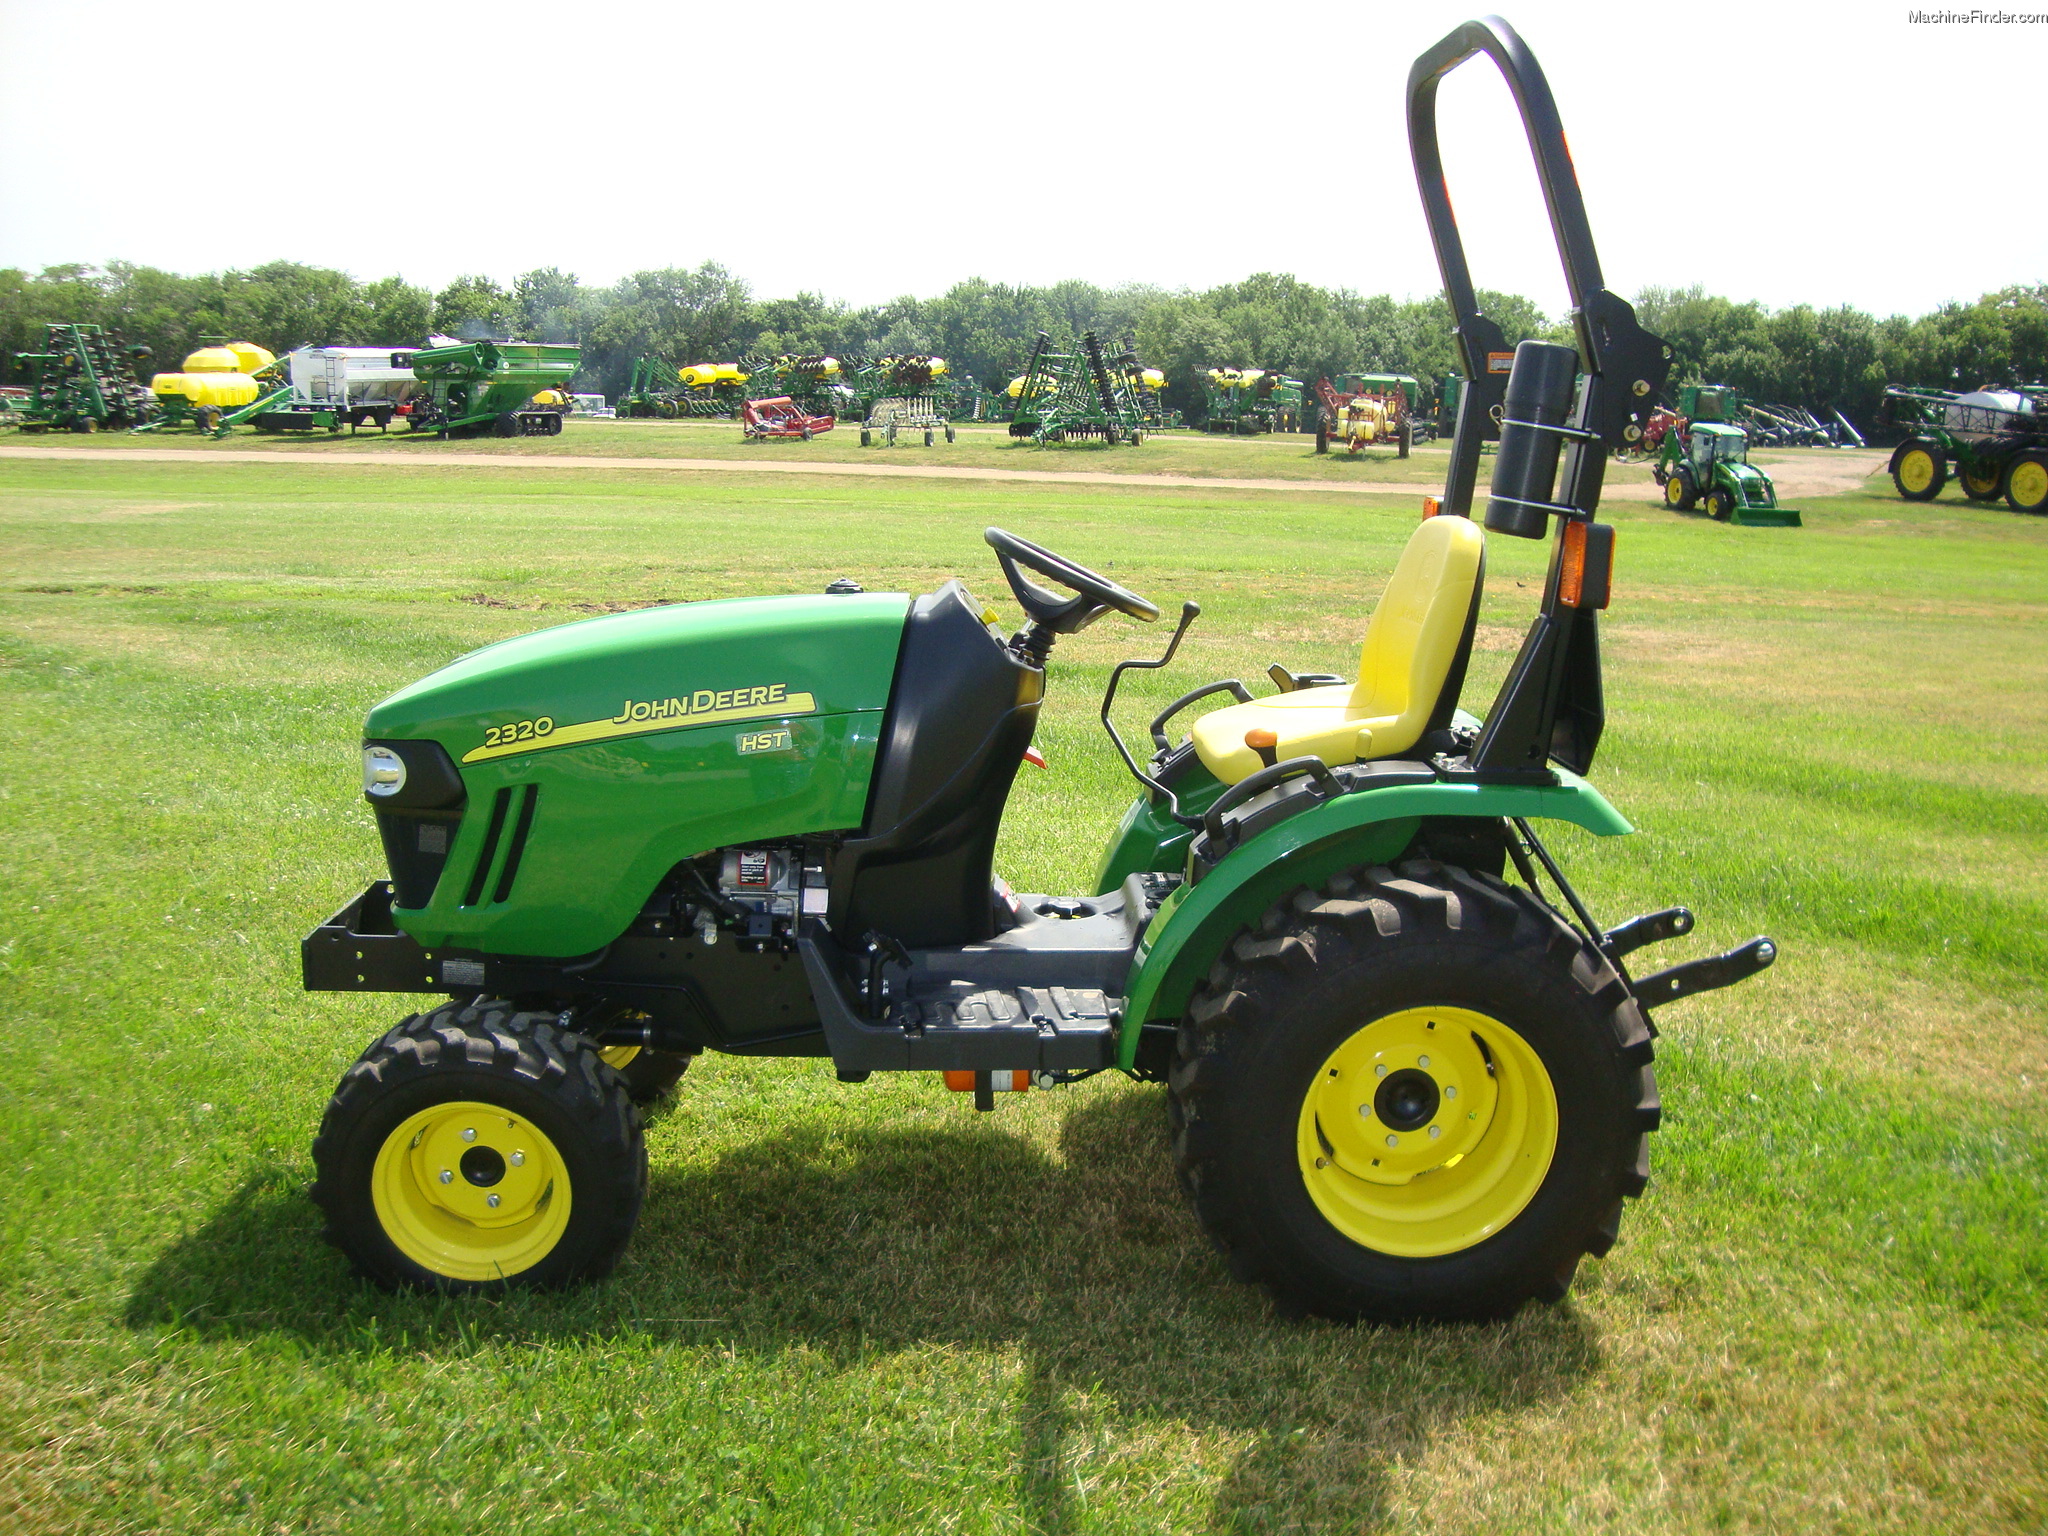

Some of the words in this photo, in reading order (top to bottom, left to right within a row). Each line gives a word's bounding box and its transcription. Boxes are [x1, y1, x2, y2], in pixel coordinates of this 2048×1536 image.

[613, 695, 692, 724] JOHN
[691, 683, 786, 712] DEERE
[484, 716, 554, 748] 2320
[740, 731, 787, 753] HST
